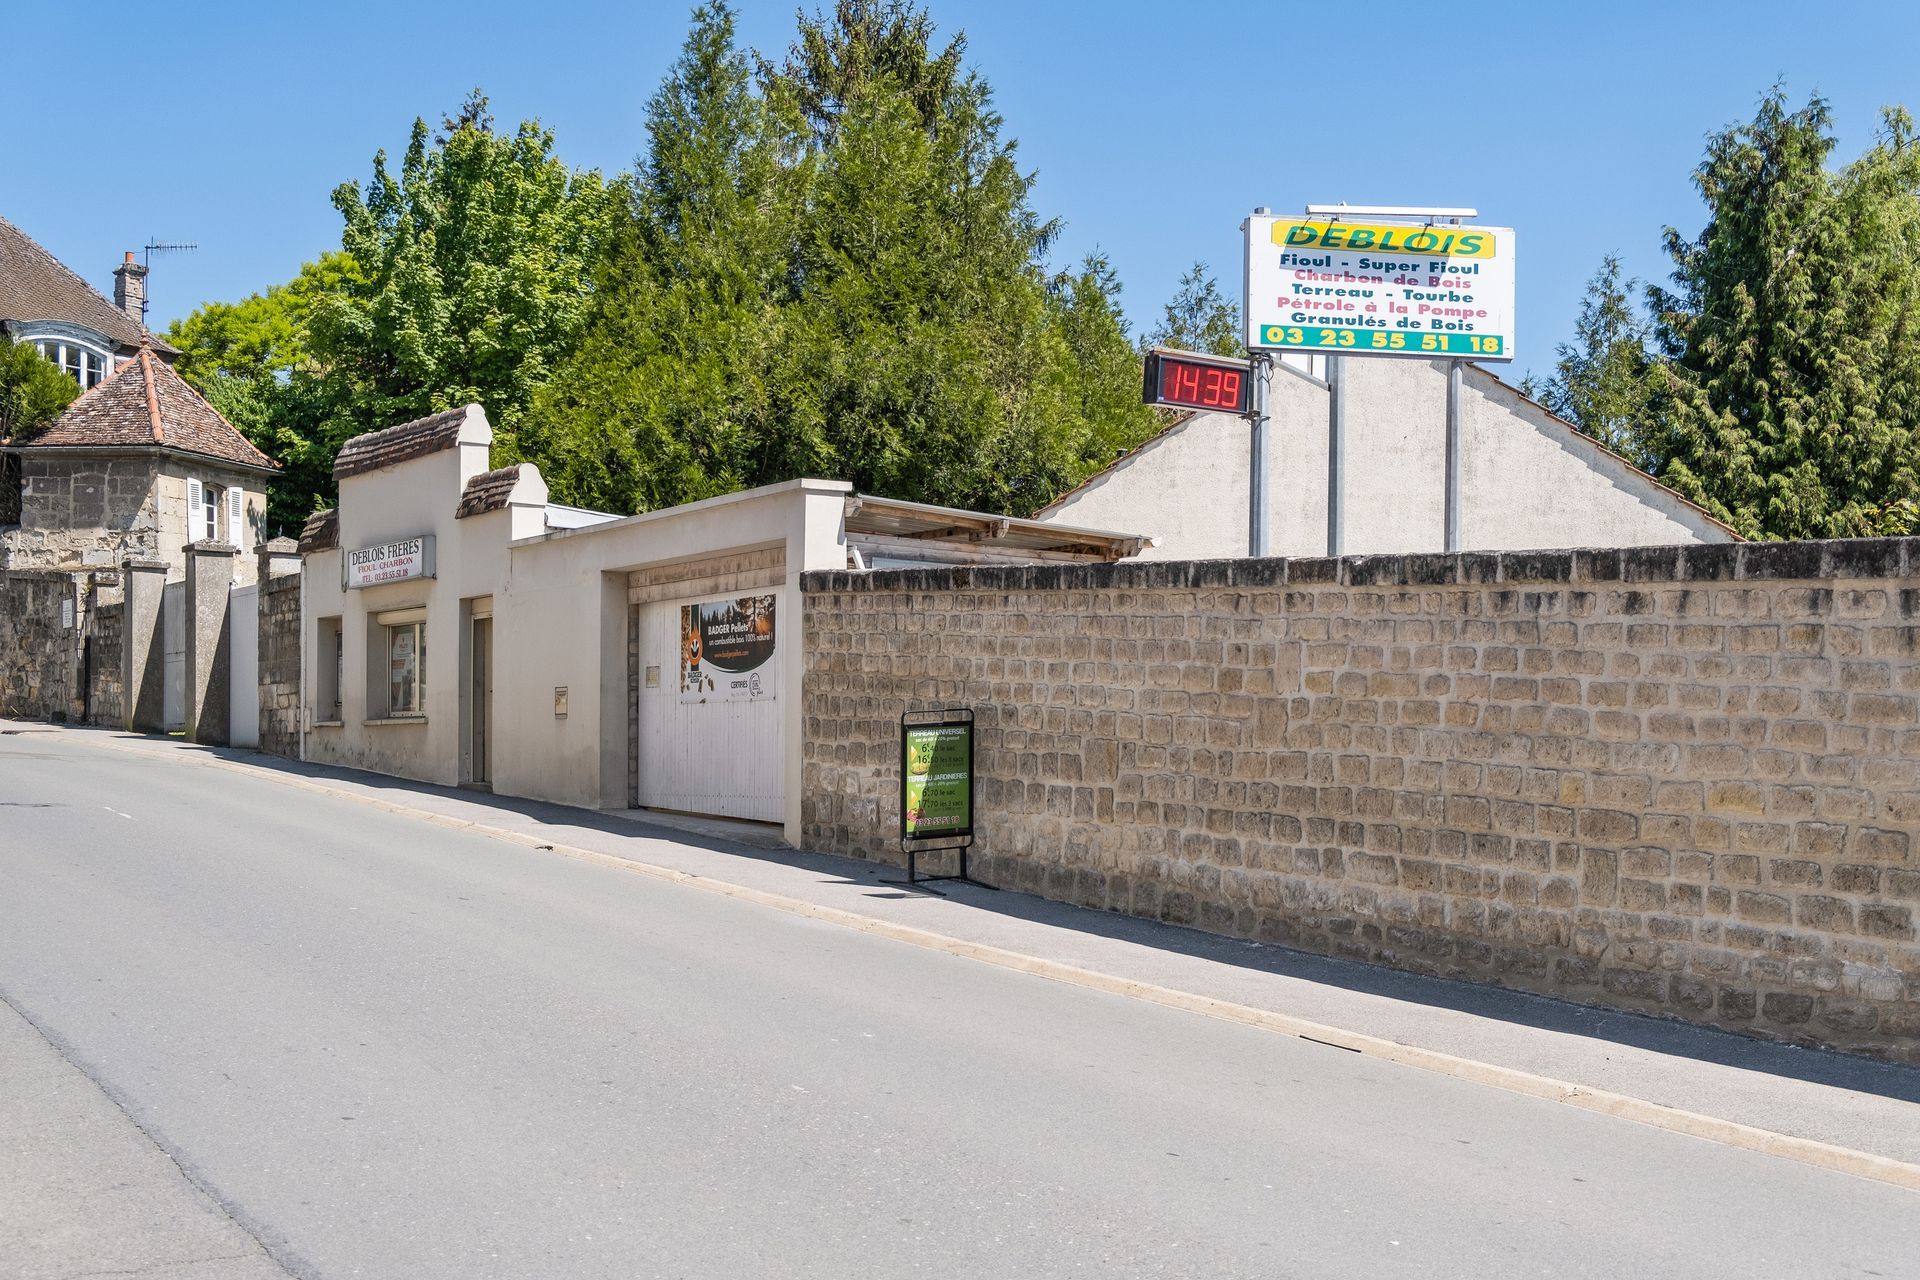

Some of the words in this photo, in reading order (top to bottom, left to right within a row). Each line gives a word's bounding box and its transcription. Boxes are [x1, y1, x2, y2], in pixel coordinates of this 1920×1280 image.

[1283, 225, 1484, 255] DEBLOIS
[1280, 254, 1331, 268] Fioul
[1358, 257, 1421, 275] Super
[1429, 261, 1479, 275] Fioul
[1294, 269, 1383, 285] Charbon
[1393, 273, 1419, 287] de
[1429, 276, 1472, 289] Bois
[1291, 283, 1374, 298] Terreau
[1402, 289, 1474, 303] Tourbe
[1277, 297, 1355, 311] Pétrole
[1365, 302, 1377, 313] à
[1389, 301, 1408, 314] la
[1418, 303, 1488, 320] Pompe
[1291, 312, 1387, 328] Granulés
[1396, 316, 1421, 329] de
[1431, 319, 1474, 331] Bois
[1266, 327, 1304, 344] 03
[1319, 329, 1356, 346] 23
[1371, 332, 1406, 349] 55
[1421, 334, 1449, 351] 51
[1470, 336, 1499, 353] 18
[352, 546, 385, 566] DEBLOIS
[387, 539, 420, 559] FRERES
[358, 563, 377, 574] FIOUL
[379, 556, 414, 570] CHARBON
[708, 624, 730, 636] BADGER
[736, 635, 745, 643] bois
[745, 634, 756, 642] 100%
[936, 728, 966, 736] UNIVERSEL
[907, 774, 933, 783] TERREAU
